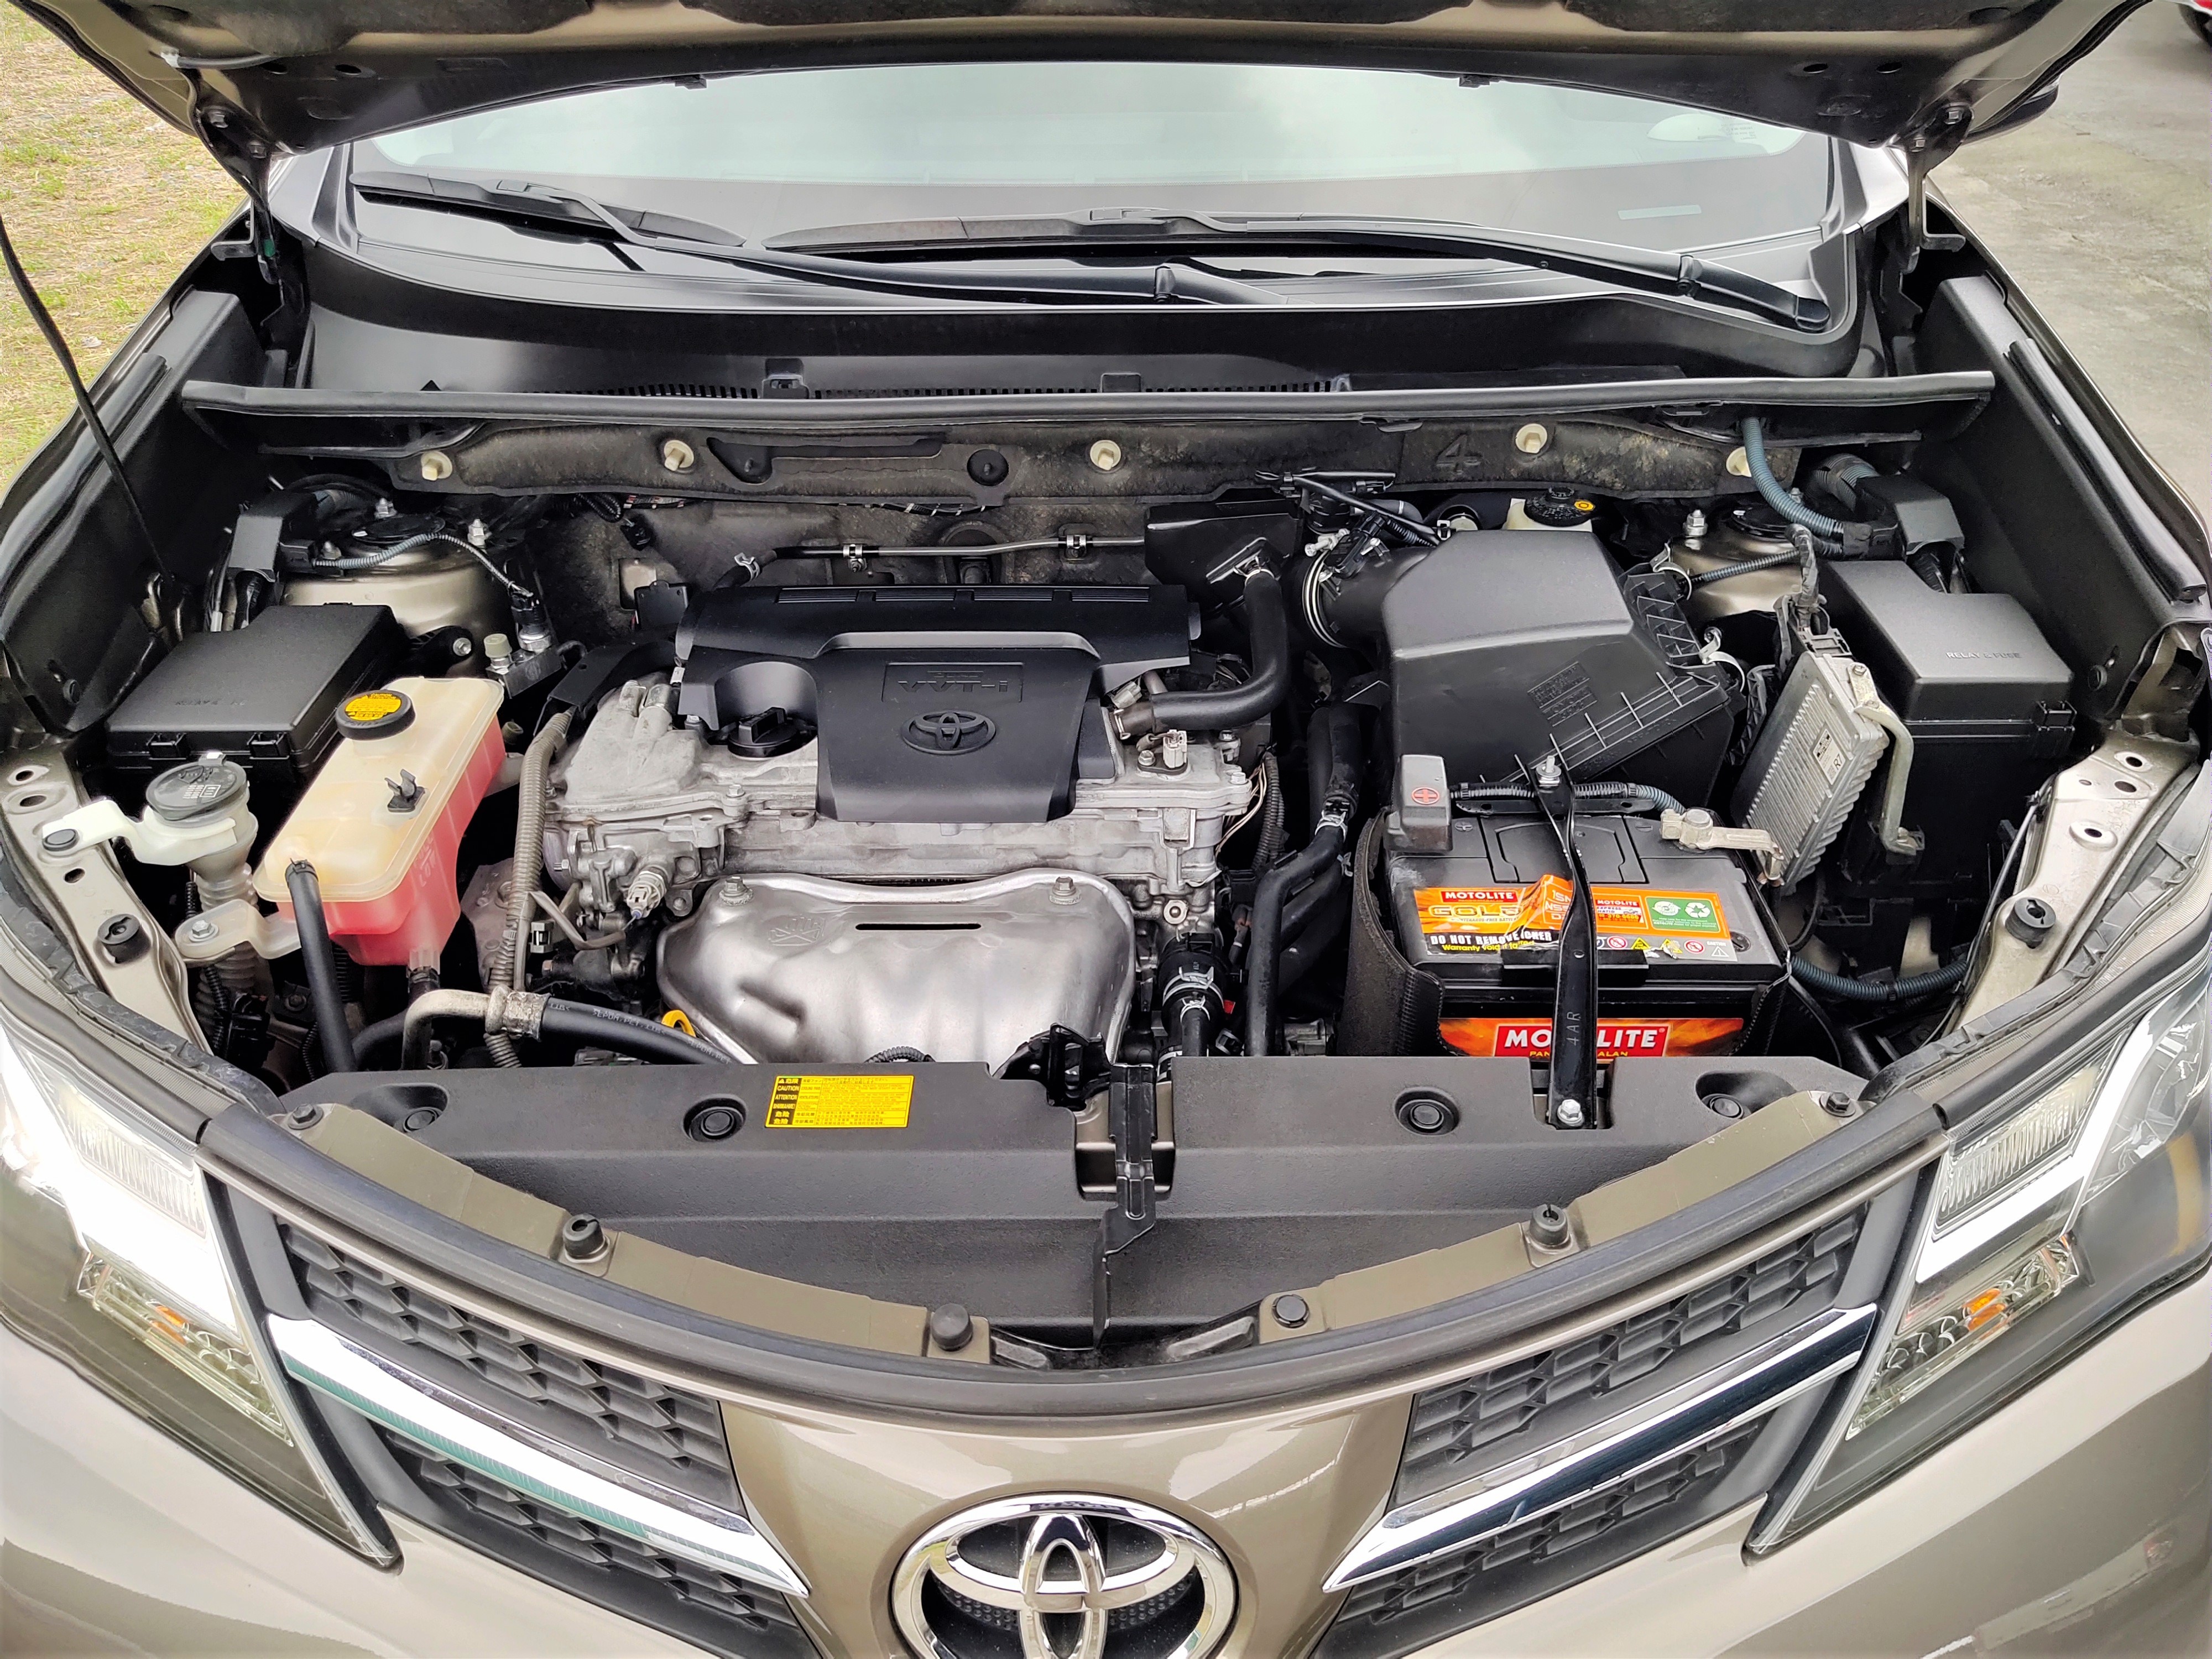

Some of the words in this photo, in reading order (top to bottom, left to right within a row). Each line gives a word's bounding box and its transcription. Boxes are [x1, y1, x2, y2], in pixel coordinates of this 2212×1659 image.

[898, 681, 1008, 692] VVT-i
[1428, 905, 1523, 917] GOLD
[1430, 935, 1446, 945] DO
[1450, 935, 1471, 945] NOT
[1475, 931, 1519, 945] REMOVE
[1566, 1011, 1581, 1046] 4AR
[1504, 1029, 1658, 1048] MOLITE
